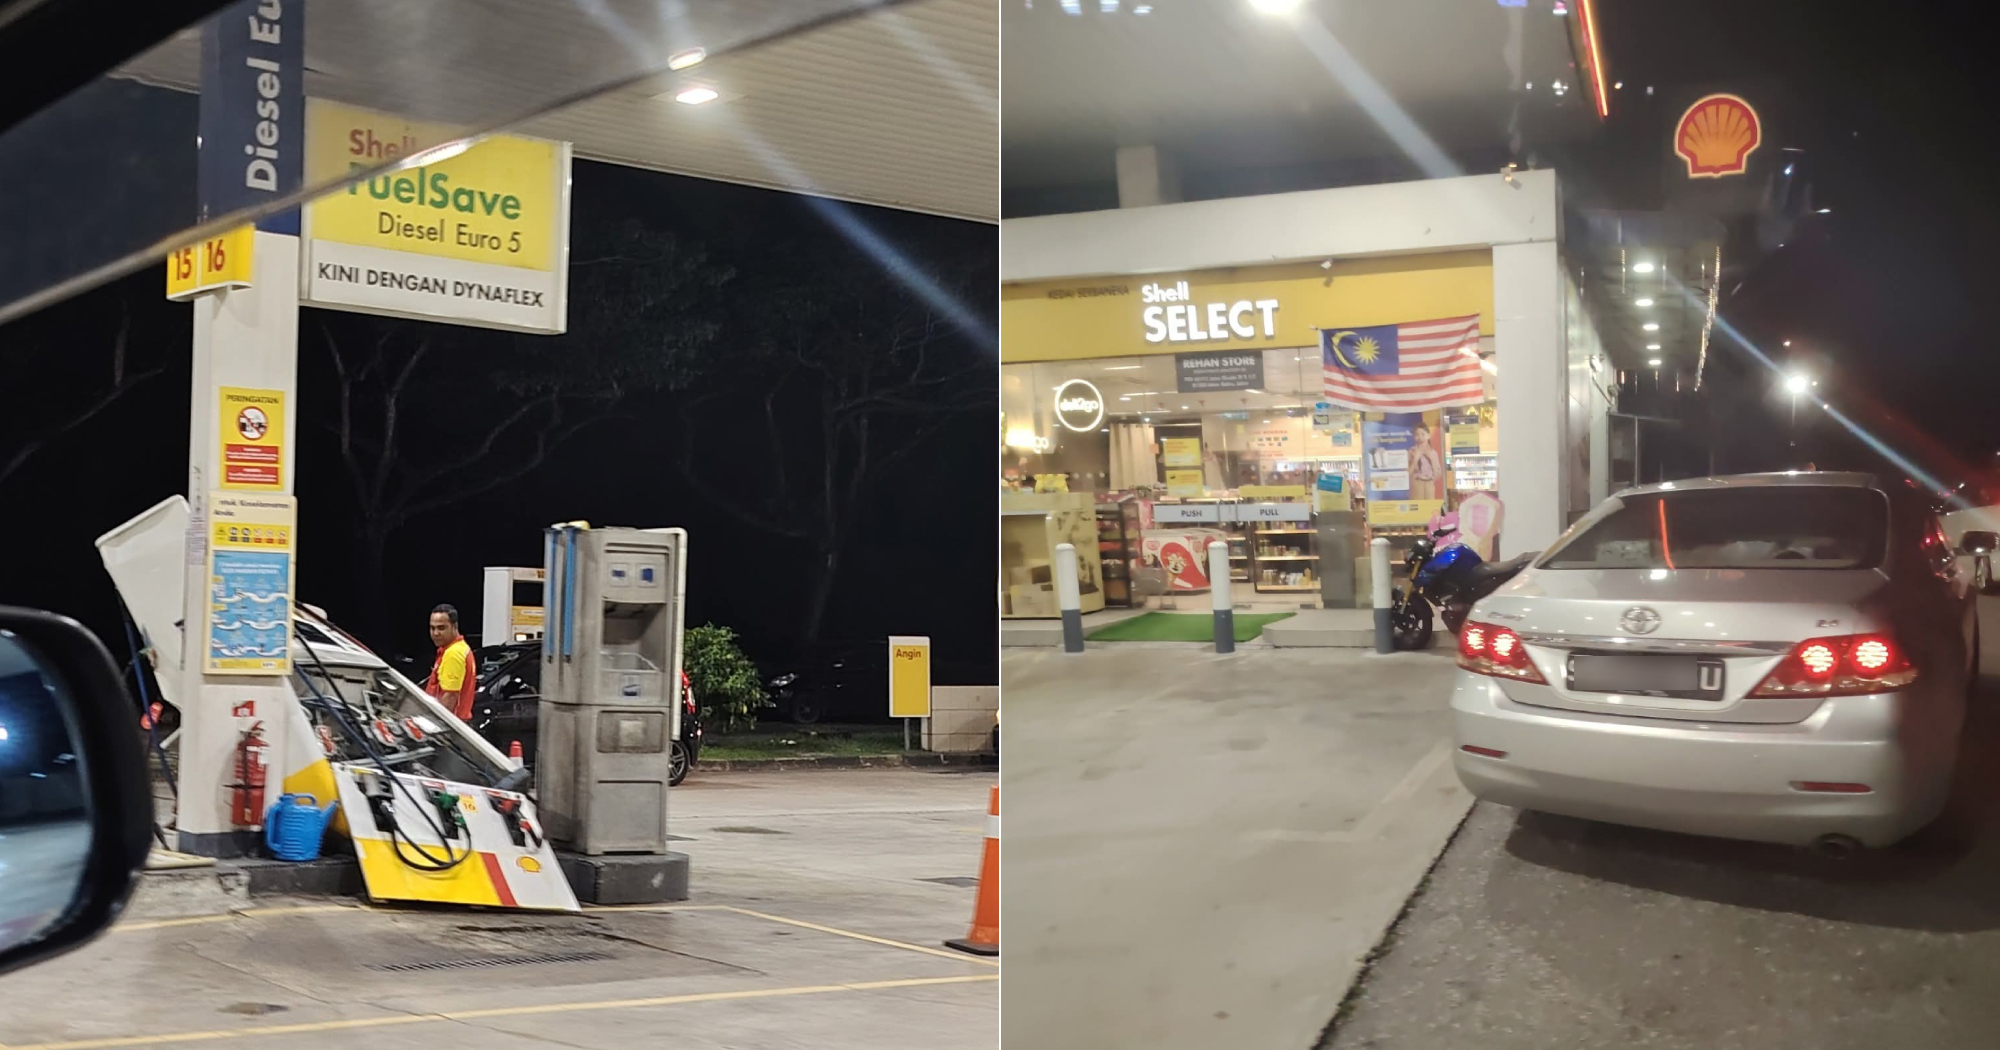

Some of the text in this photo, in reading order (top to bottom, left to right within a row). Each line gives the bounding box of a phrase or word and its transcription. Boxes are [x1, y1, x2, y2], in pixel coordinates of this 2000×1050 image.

[245, 57, 281, 192] Diesel
[378, 211, 521, 253] Diesel Euro 5
[174, 239, 225, 281] 15 16
[318, 262, 544, 308] KINI DENGAN DYNAFLEX
[1141, 281, 1190, 303] Shell
[1143, 299, 1279, 343] SELECT
[1183, 356, 1255, 369] REHAN STORE
[1181, 510, 1203, 519] PUSH
[1260, 509, 1279, 517] PULL
[896, 648, 921, 661] Angin
